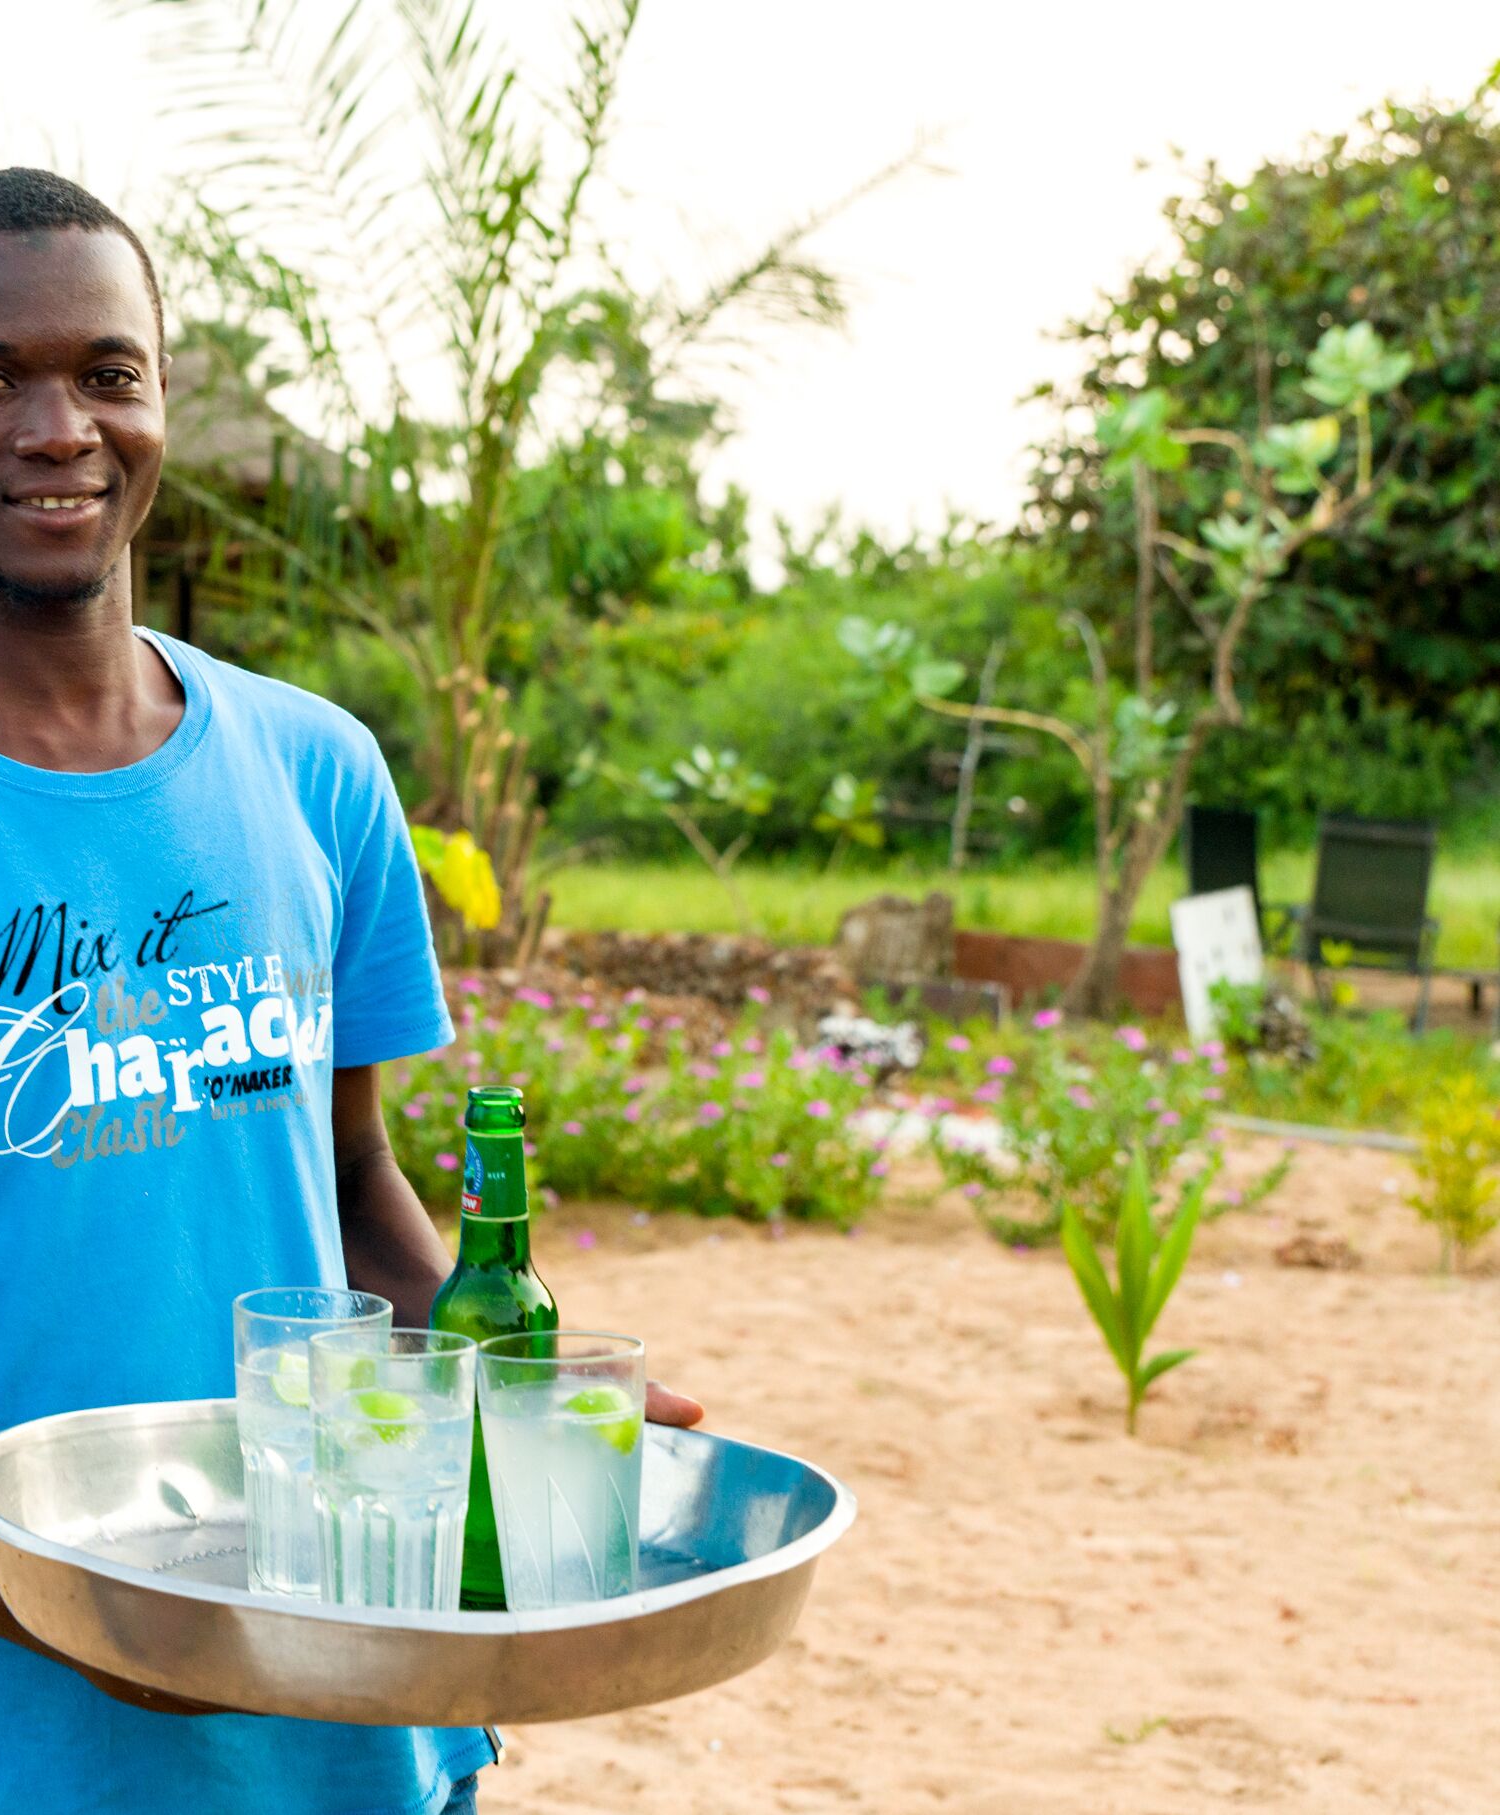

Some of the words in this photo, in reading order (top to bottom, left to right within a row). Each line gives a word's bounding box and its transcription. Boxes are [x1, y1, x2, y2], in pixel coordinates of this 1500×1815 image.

[137, 889, 228, 967] it
[95, 975, 168, 1035] the
[167, 953, 284, 1006] STYLE
[51, 1094, 186, 1168] Clash
